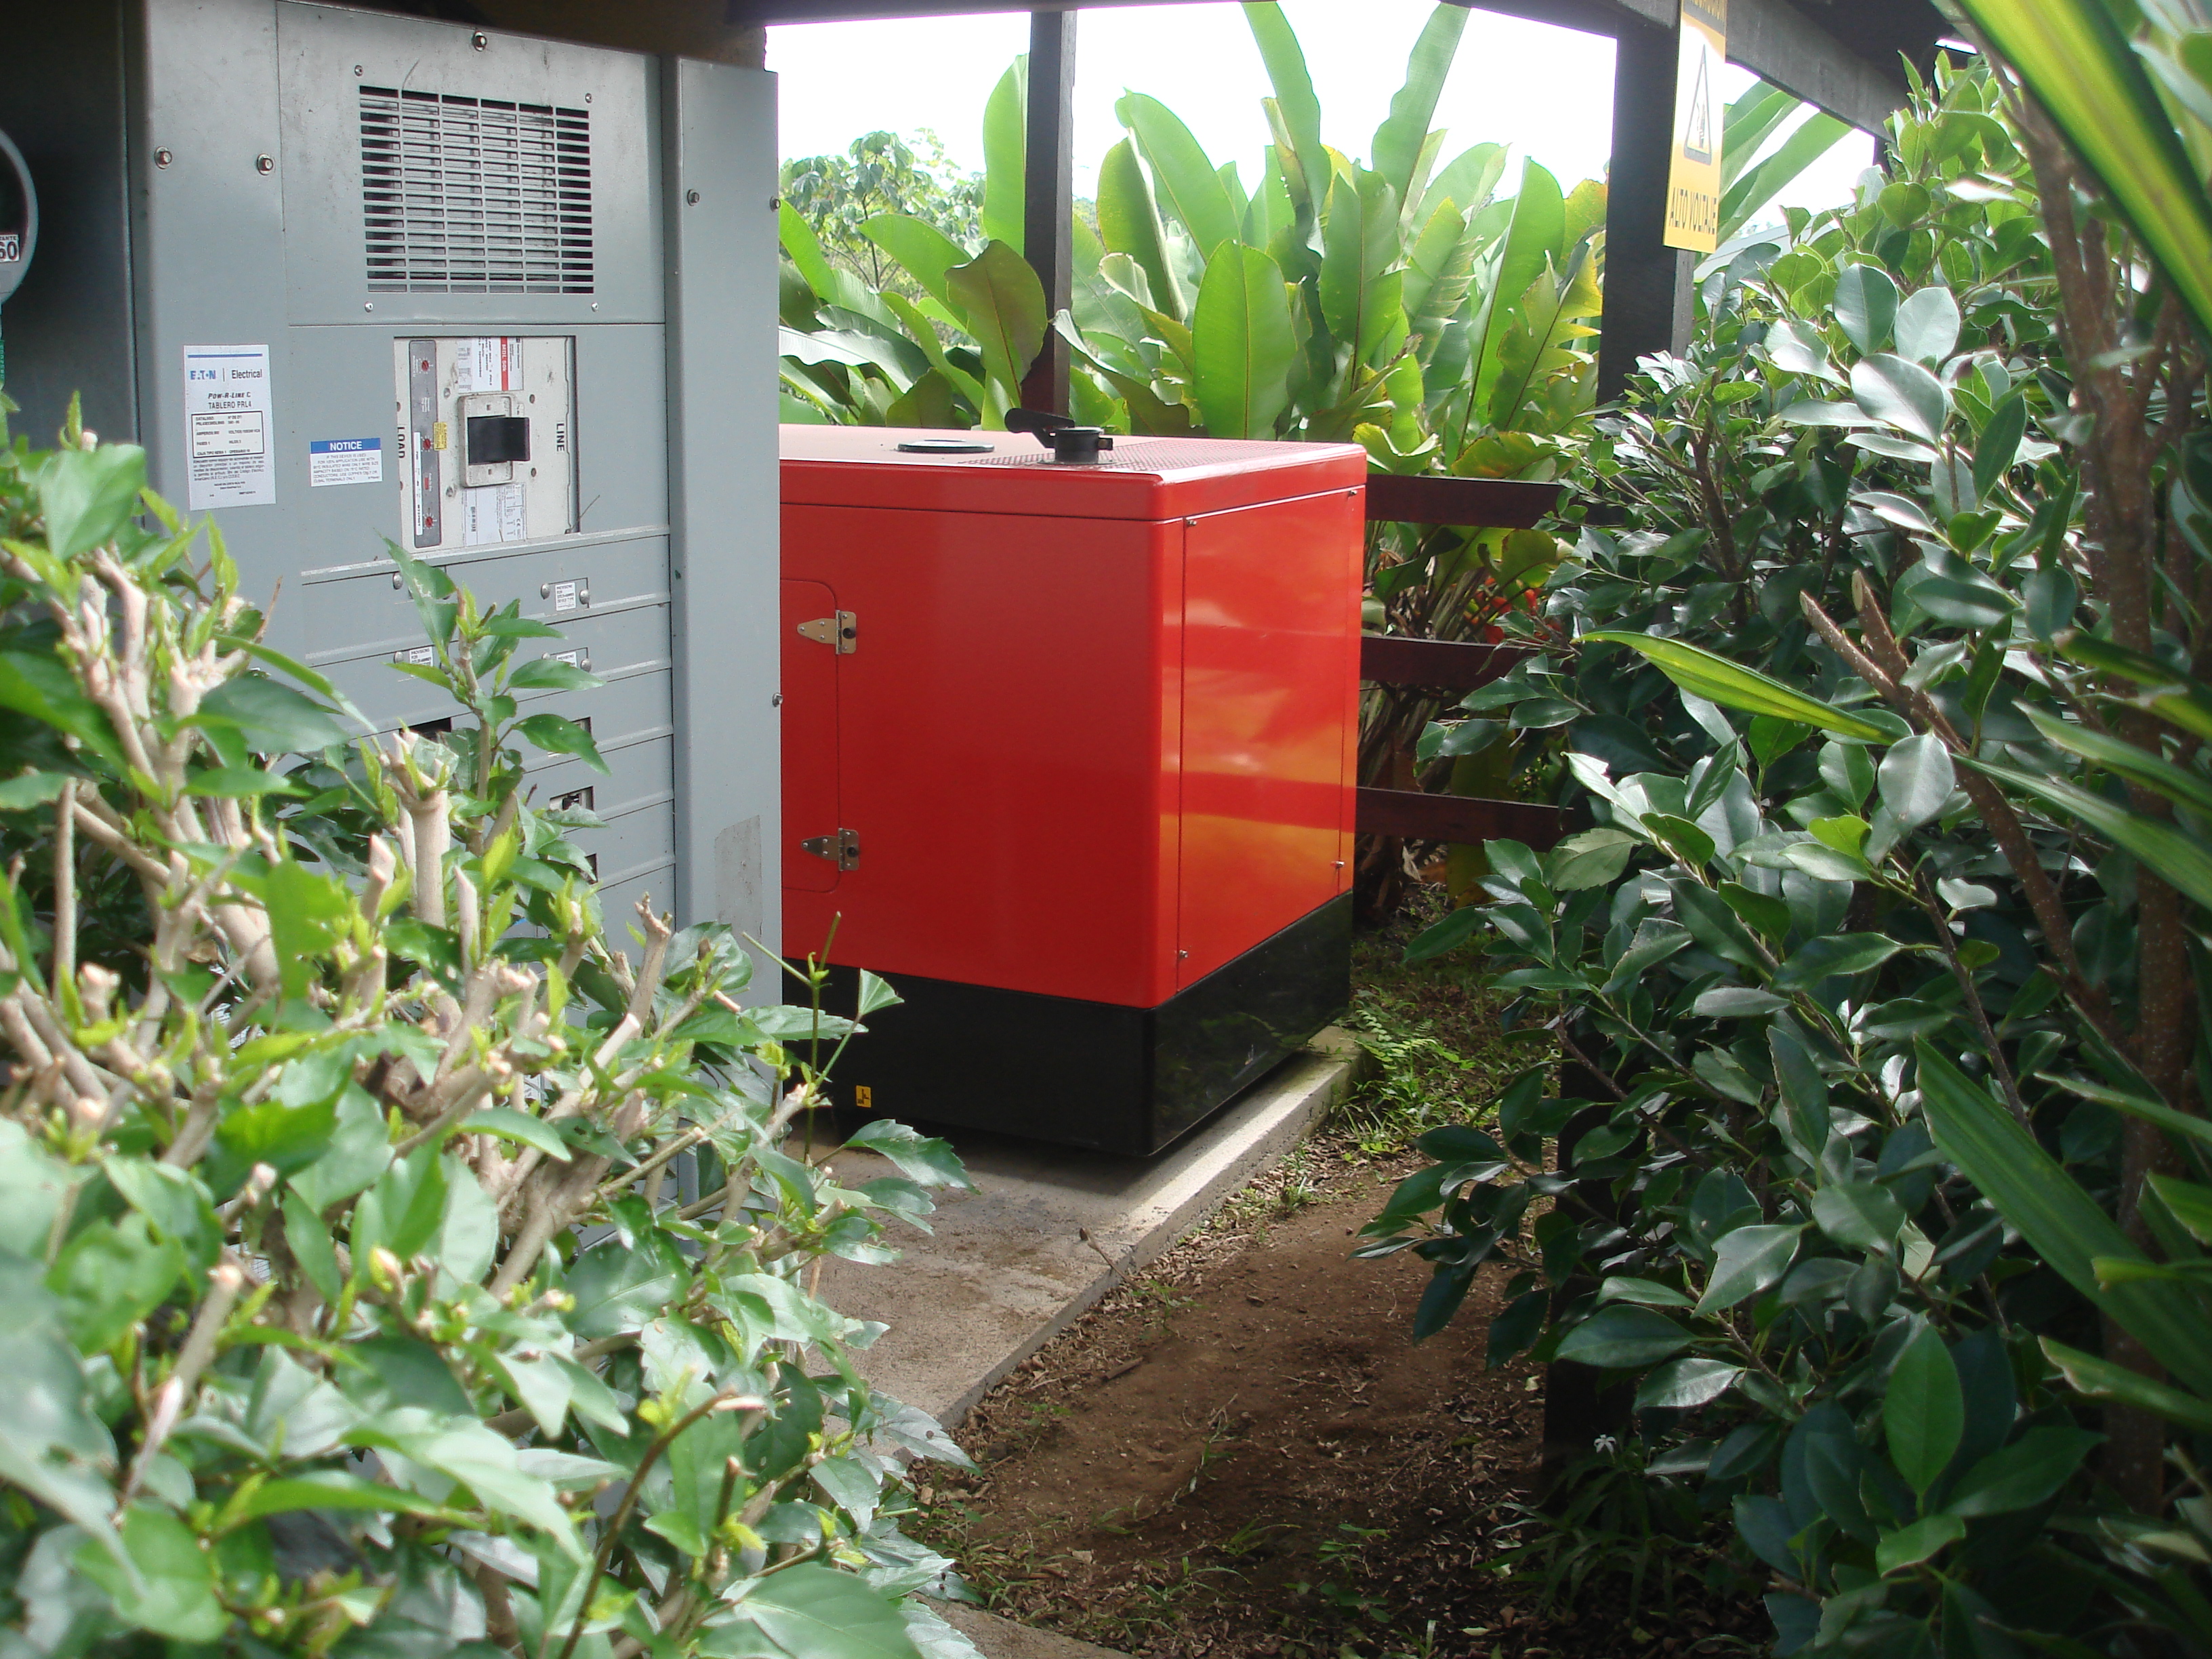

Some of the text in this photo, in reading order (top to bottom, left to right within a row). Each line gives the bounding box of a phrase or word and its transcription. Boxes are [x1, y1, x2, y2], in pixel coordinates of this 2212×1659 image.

[1668, 187, 1688, 229] ALTO
[231, 369, 262, 380] Electrical
[208, 401, 236, 409] TABLERO
[329, 441, 363, 451] NOTICE
[397, 427, 405, 458] LOAD
[556, 423, 565, 451] LINE
